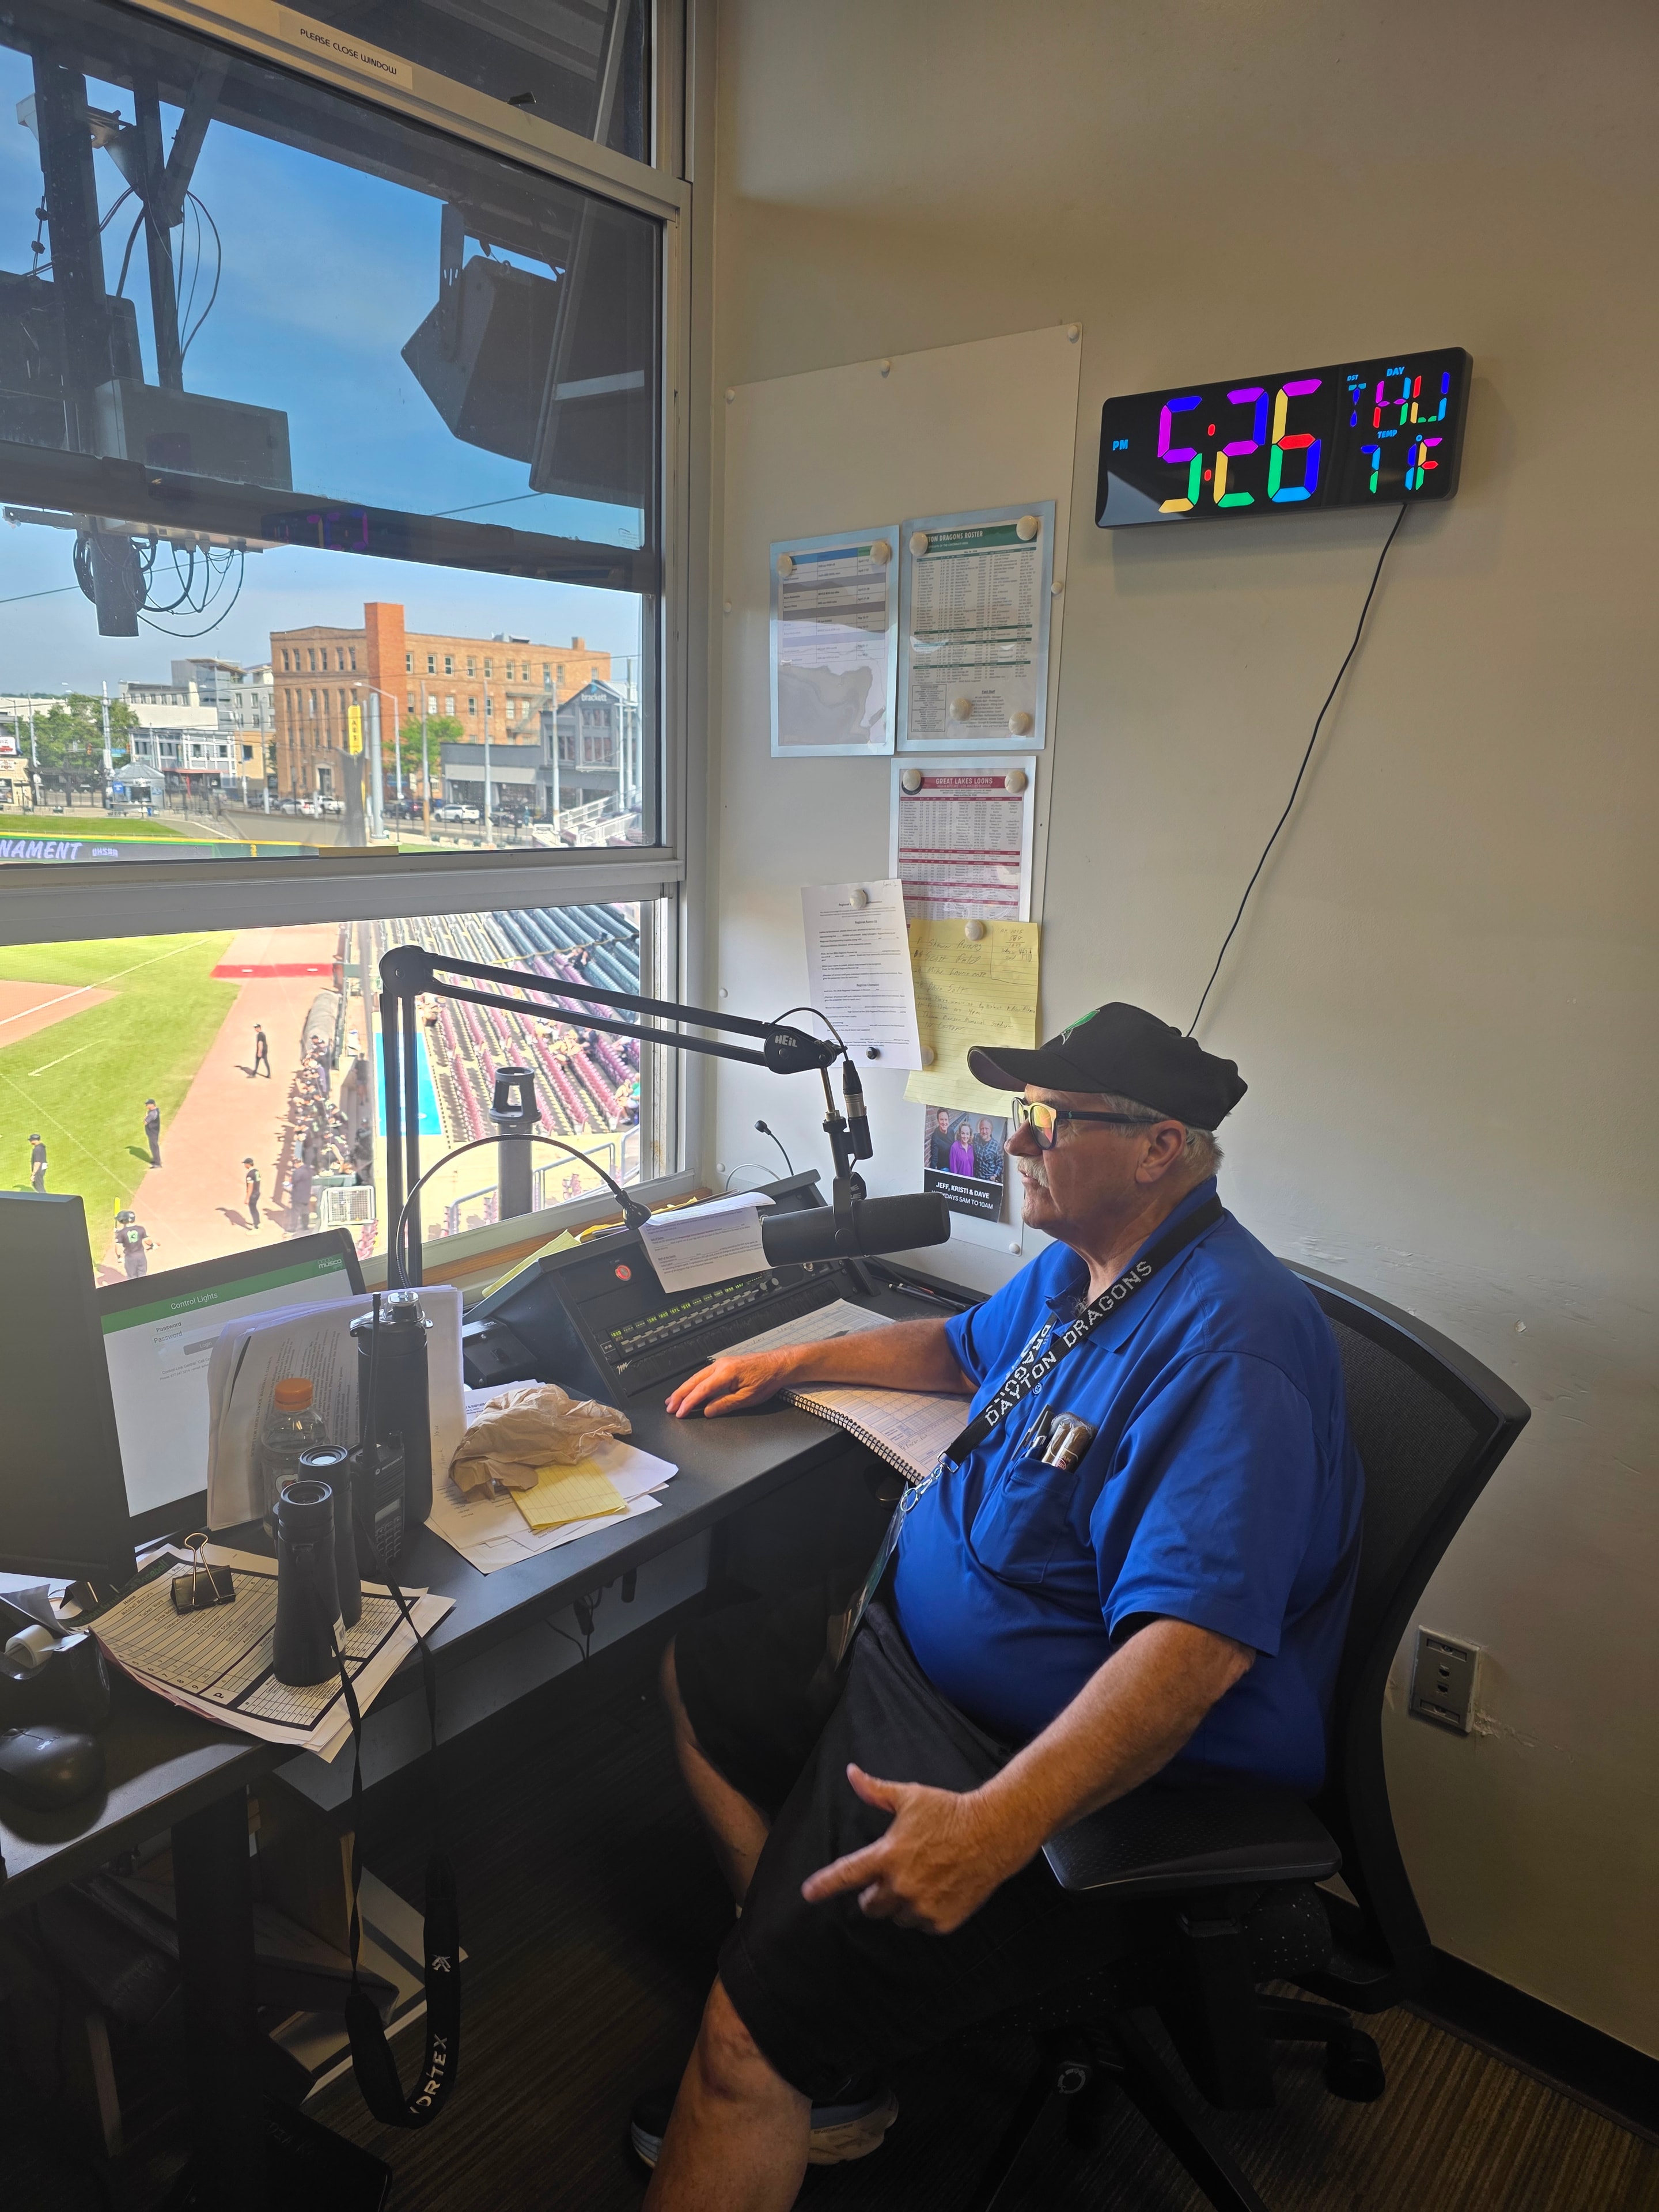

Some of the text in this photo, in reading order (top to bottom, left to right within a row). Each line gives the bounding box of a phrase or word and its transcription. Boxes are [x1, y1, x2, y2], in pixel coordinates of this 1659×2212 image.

[300, 28, 397, 75] PLEASE CLOSE WINDOW
[1387, 366, 1405, 377] DAY
[1349, 372, 1450, 429] THU
[1377, 429, 1397, 439] TEMP
[1112, 440, 1129, 451] PM
[1157, 379, 1322, 513] 5:26
[940, 533, 963, 541] DRAGONS
[964, 531, 983, 539] ROSTER
[936, 1182, 950, 1191] JEFF,
[951, 1185, 969, 1195] KRISTI
[974, 1190, 990, 1199] DAVE
[979, 1201, 993, 1210] 10AM
[171, 1293, 218, 1310] Control Lights
[156, 1321, 182, 1332] Password
[154, 1330, 183, 1344] Password
[985, 1260, 1153, 1426] DAYTON DRAGONS
[200, 1340, 213, 1349] Login
[259, 1372, 268, 1397] BASEBALL
[135, 1560, 169, 1585] Baseball
[123, 1595, 137, 1605] Name
